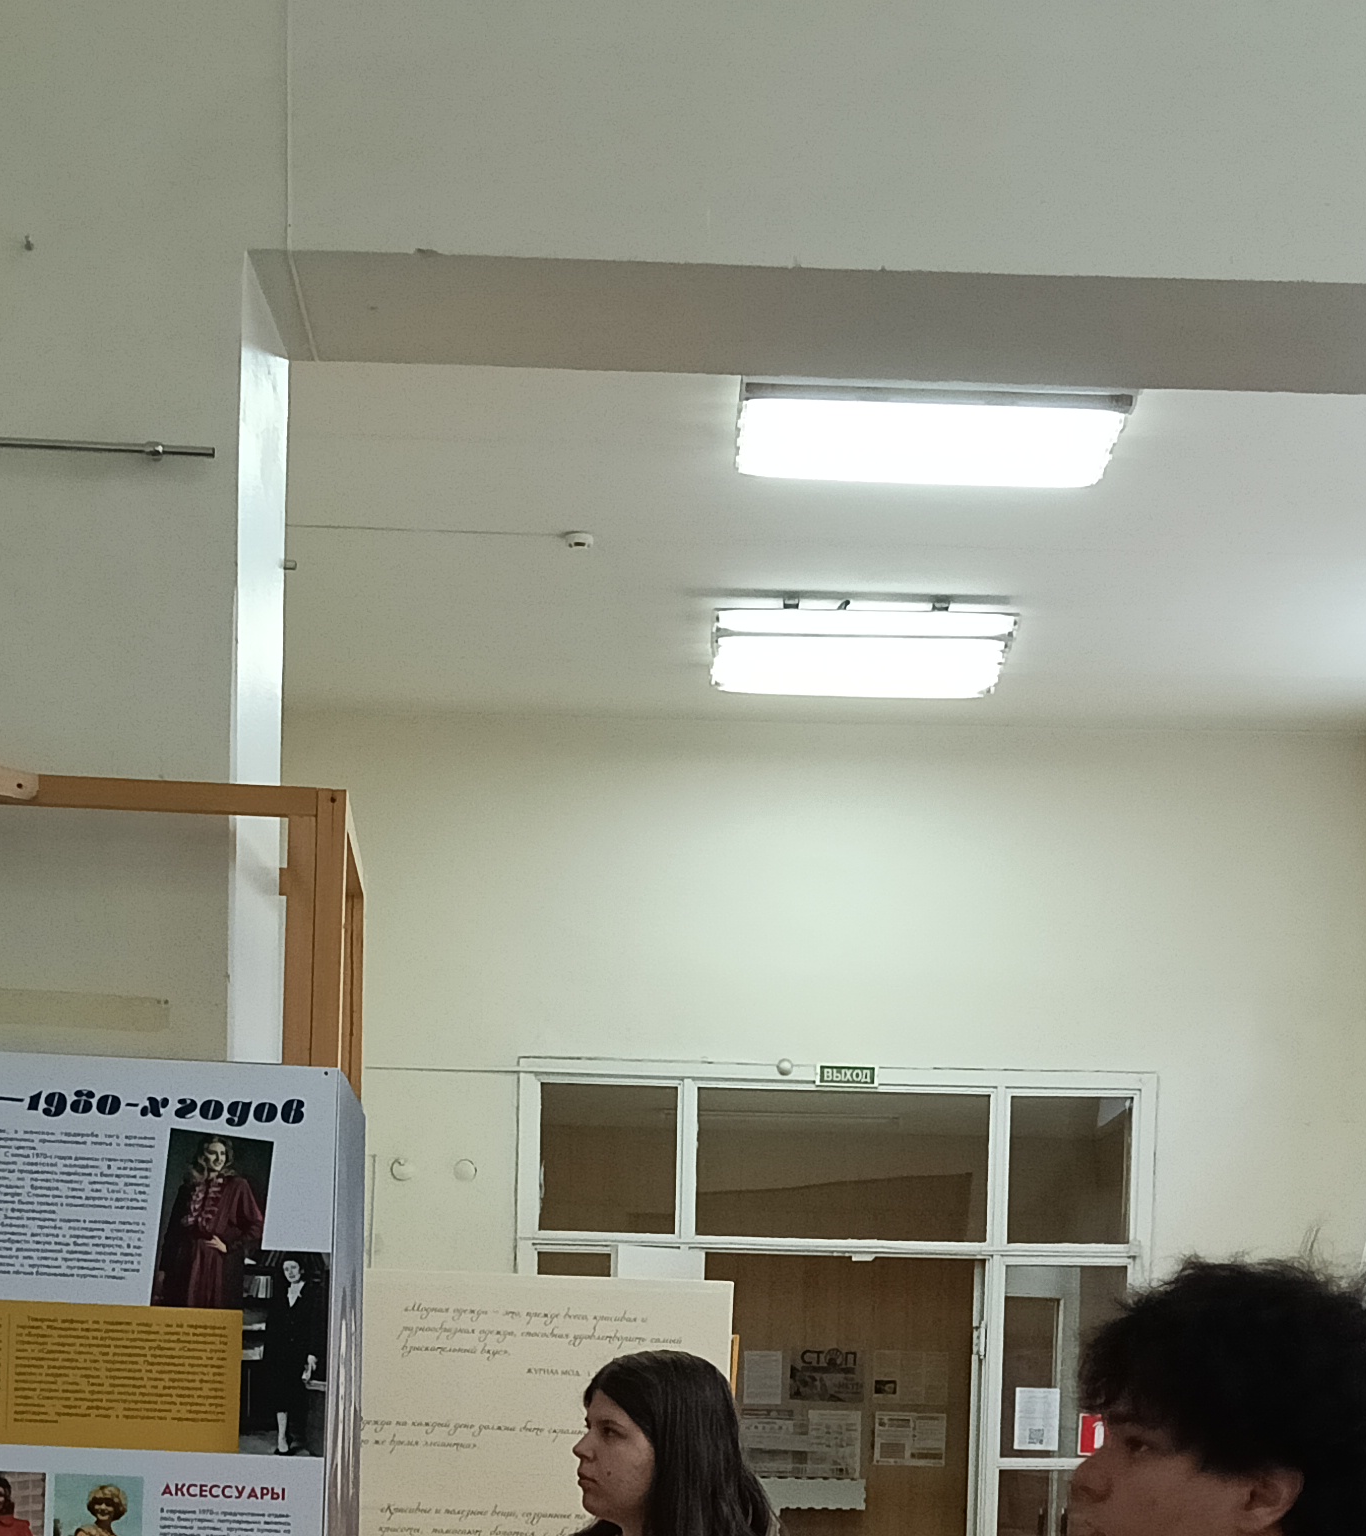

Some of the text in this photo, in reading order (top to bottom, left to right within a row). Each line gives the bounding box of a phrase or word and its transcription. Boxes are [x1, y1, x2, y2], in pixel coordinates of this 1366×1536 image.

[823, 1068, 871, 1083] ВЫХОД
[173, 1096, 306, 1127] годов
[452, 1308, 488, 1322] одежда
[526, 1310, 560, 1326] прежде
[396, 1321, 475, 1340] разнообразная
[521, 1327, 569, 1339] способная
[800, 1348, 857, 1367] СТОП
[361, 1420, 392, 1433] дежда
[412, 1421, 450, 1435] каждый
[448, 1423, 474, 1435] день
[472, 1424, 515, 1437] должна
[520, 1420, 545, 1436] быть
[389, 1434, 419, 1453] время
[161, 1482, 286, 1501] АКСЕССУАРЫ
[444, 1509, 488, 1520] полезные
[521, 1512, 571, 1525] созданные
